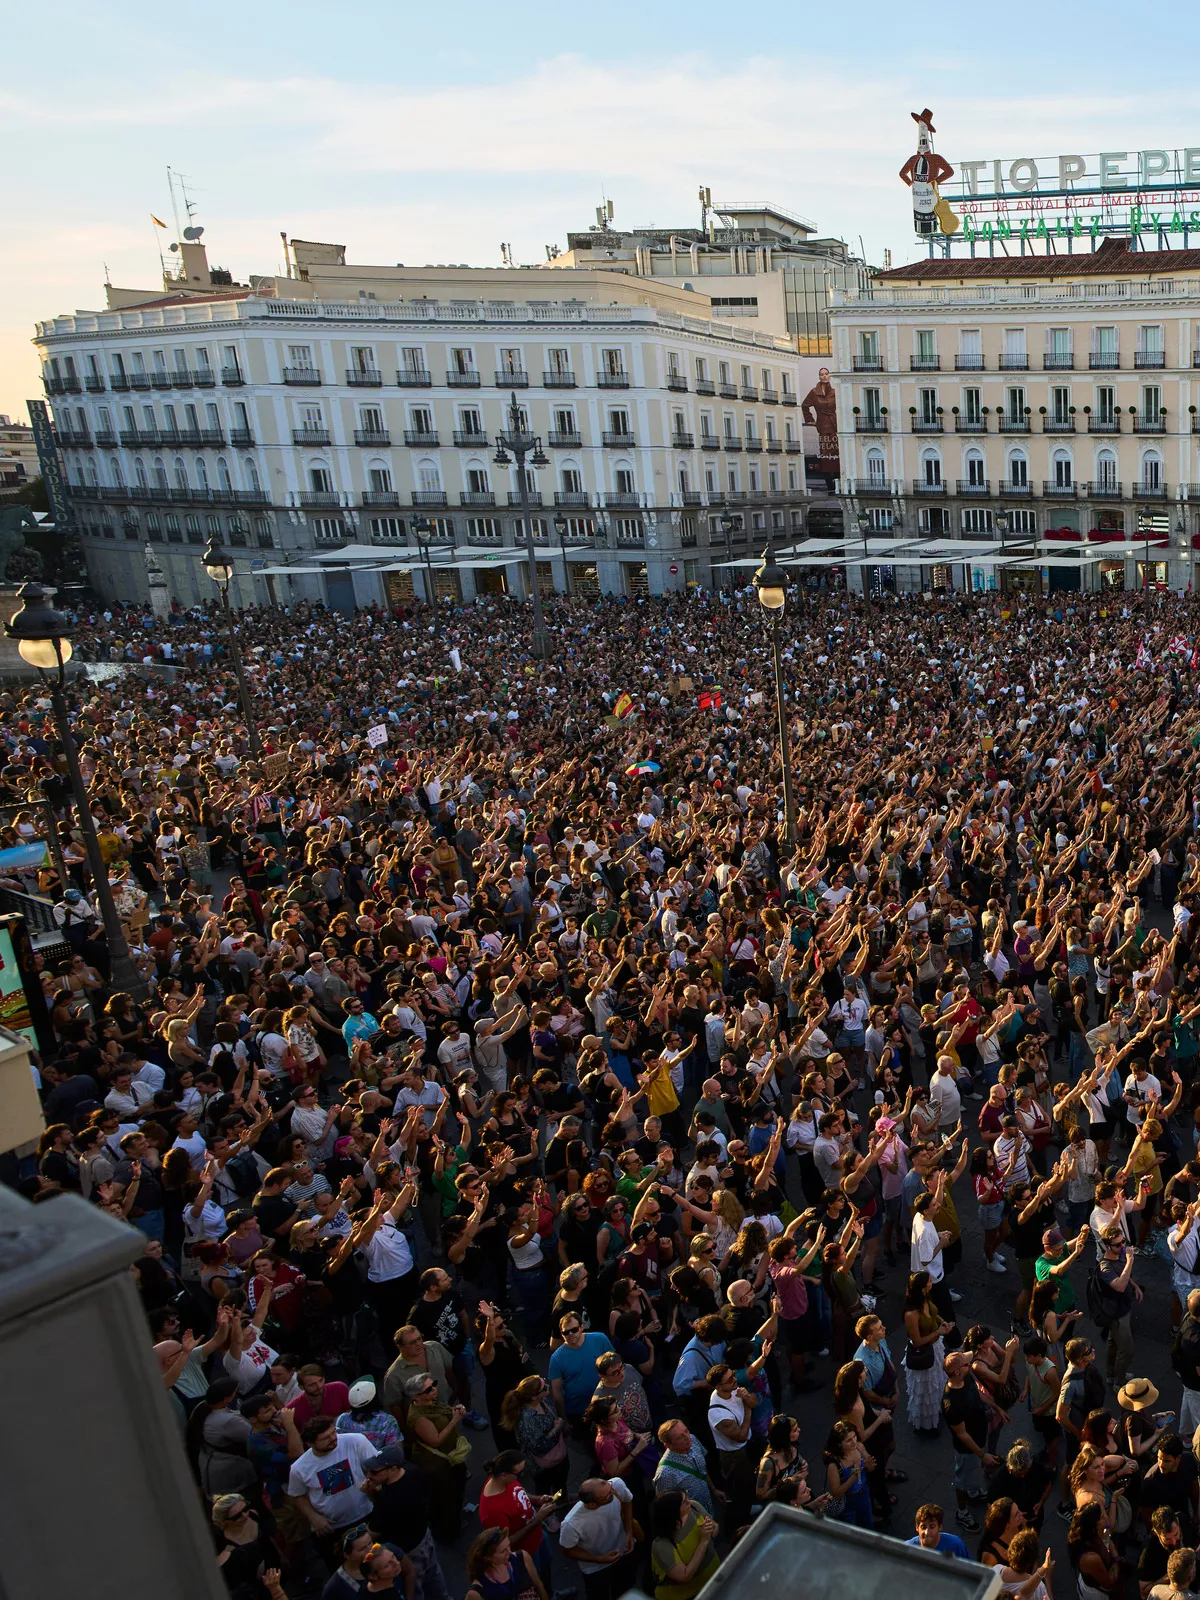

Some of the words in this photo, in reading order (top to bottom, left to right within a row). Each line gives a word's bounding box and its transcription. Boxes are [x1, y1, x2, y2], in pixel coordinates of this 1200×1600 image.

[960, 158, 1039, 195] TIO
[959, 202, 985, 214] SOL
[991, 200, 1009, 212] DE
[30, 401, 52, 450] HOTEL
[41, 456, 68, 522] MODERNO
